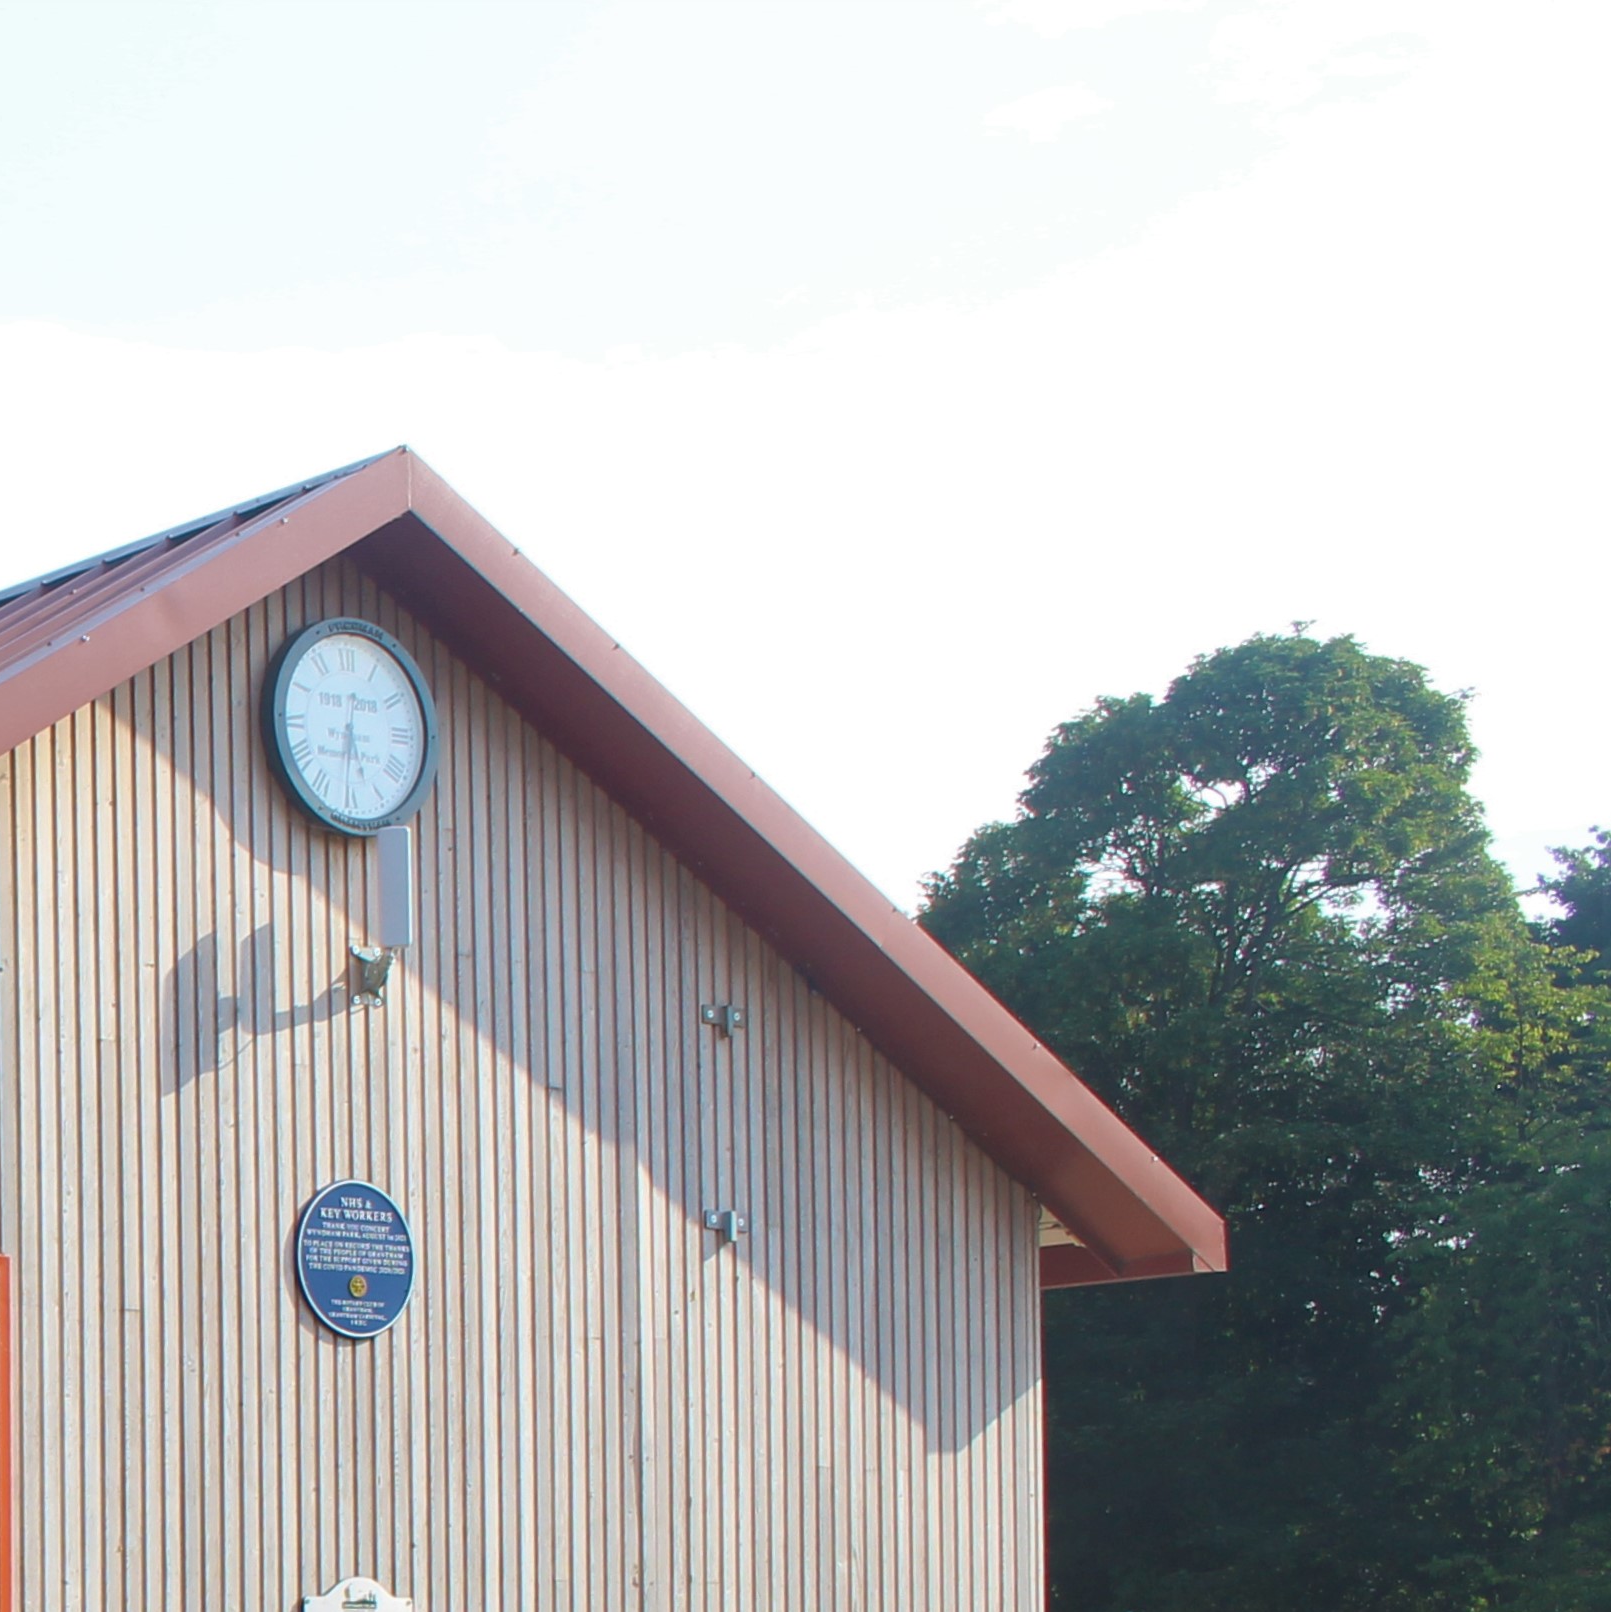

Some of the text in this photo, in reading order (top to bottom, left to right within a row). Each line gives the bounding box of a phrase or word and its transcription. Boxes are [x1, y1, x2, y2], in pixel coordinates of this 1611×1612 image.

[319, 691, 342, 708] 1918
[340, 1196, 372, 1209] NHS &
[320, 1207, 394, 1223] KEY WORKERS
[322, 1221, 345, 1230] THANK
[360, 1224, 390, 1233] CONCERT
[306, 1228, 341, 1238] WYNDHAM
[362, 1232, 386, 1241] AUGUST
[313, 1239, 333, 1248] PLACE
[371, 1243, 384, 1251] THE
[385, 1244, 410, 1253] THANKS
